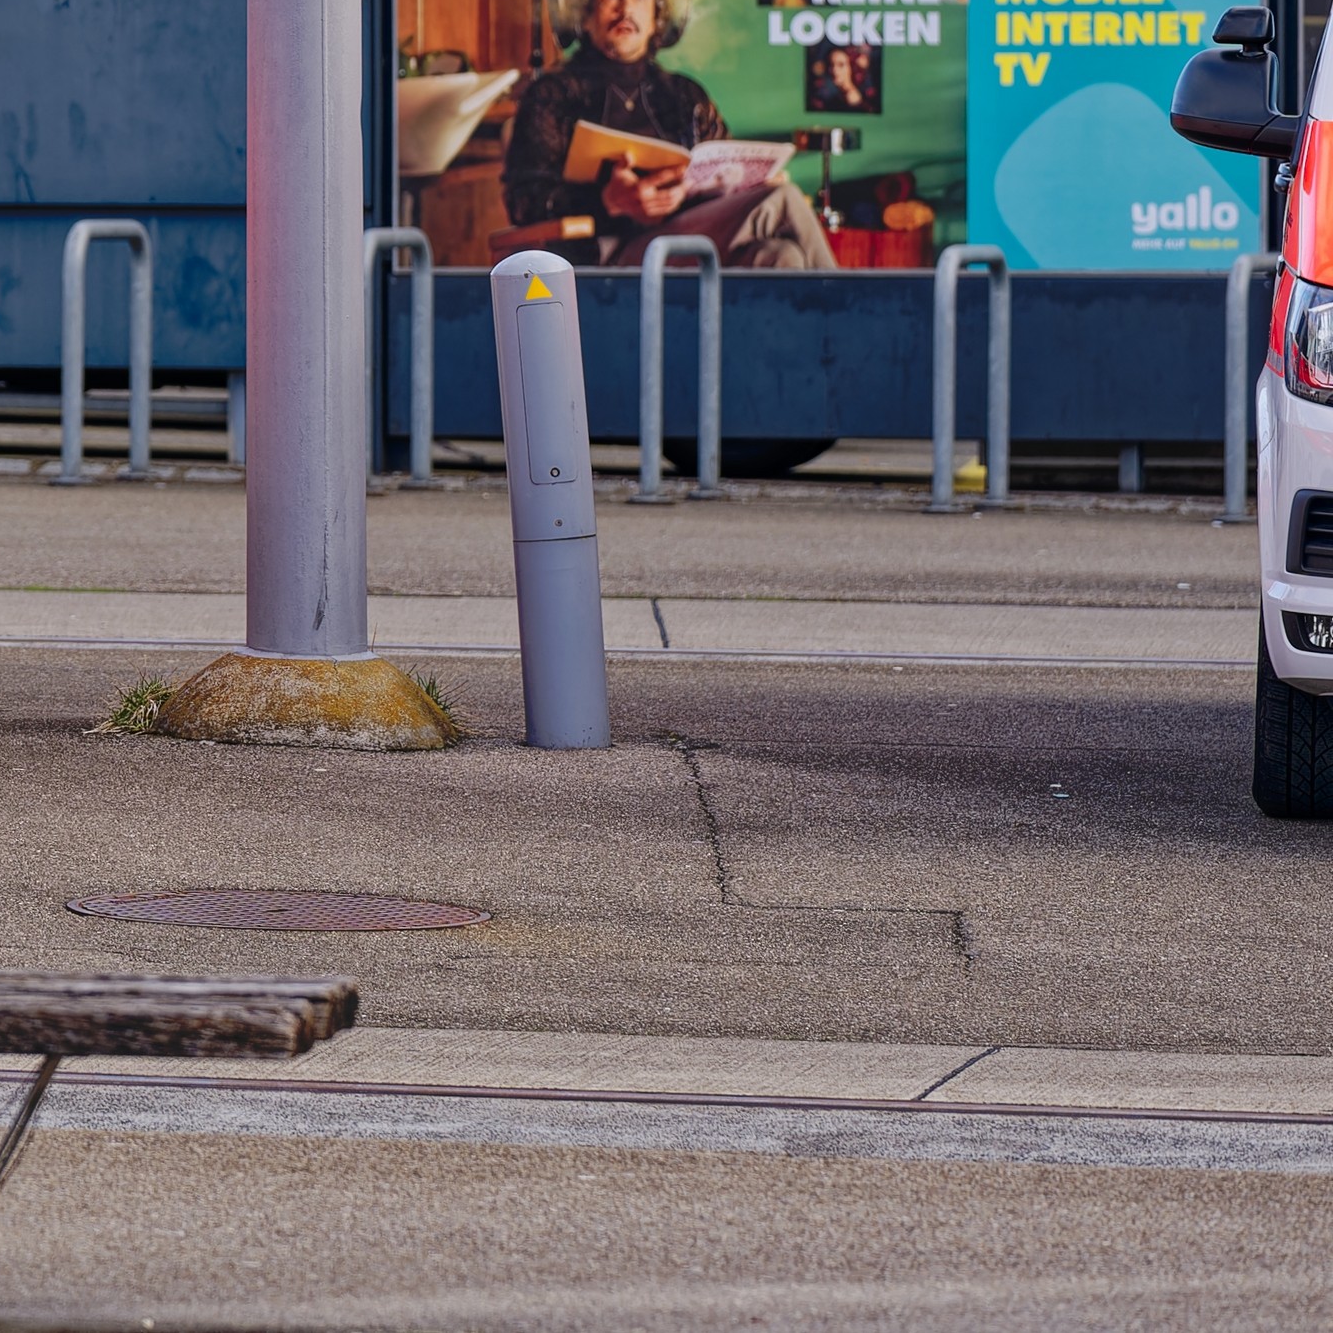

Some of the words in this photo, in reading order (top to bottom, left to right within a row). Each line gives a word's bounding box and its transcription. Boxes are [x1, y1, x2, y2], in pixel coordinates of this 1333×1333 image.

[768, 11, 941, 46] LOCKEN
[996, 11, 1205, 46] INTERNET
[995, 53, 1050, 87] TV
[1131, 185, 1240, 236] yallo
